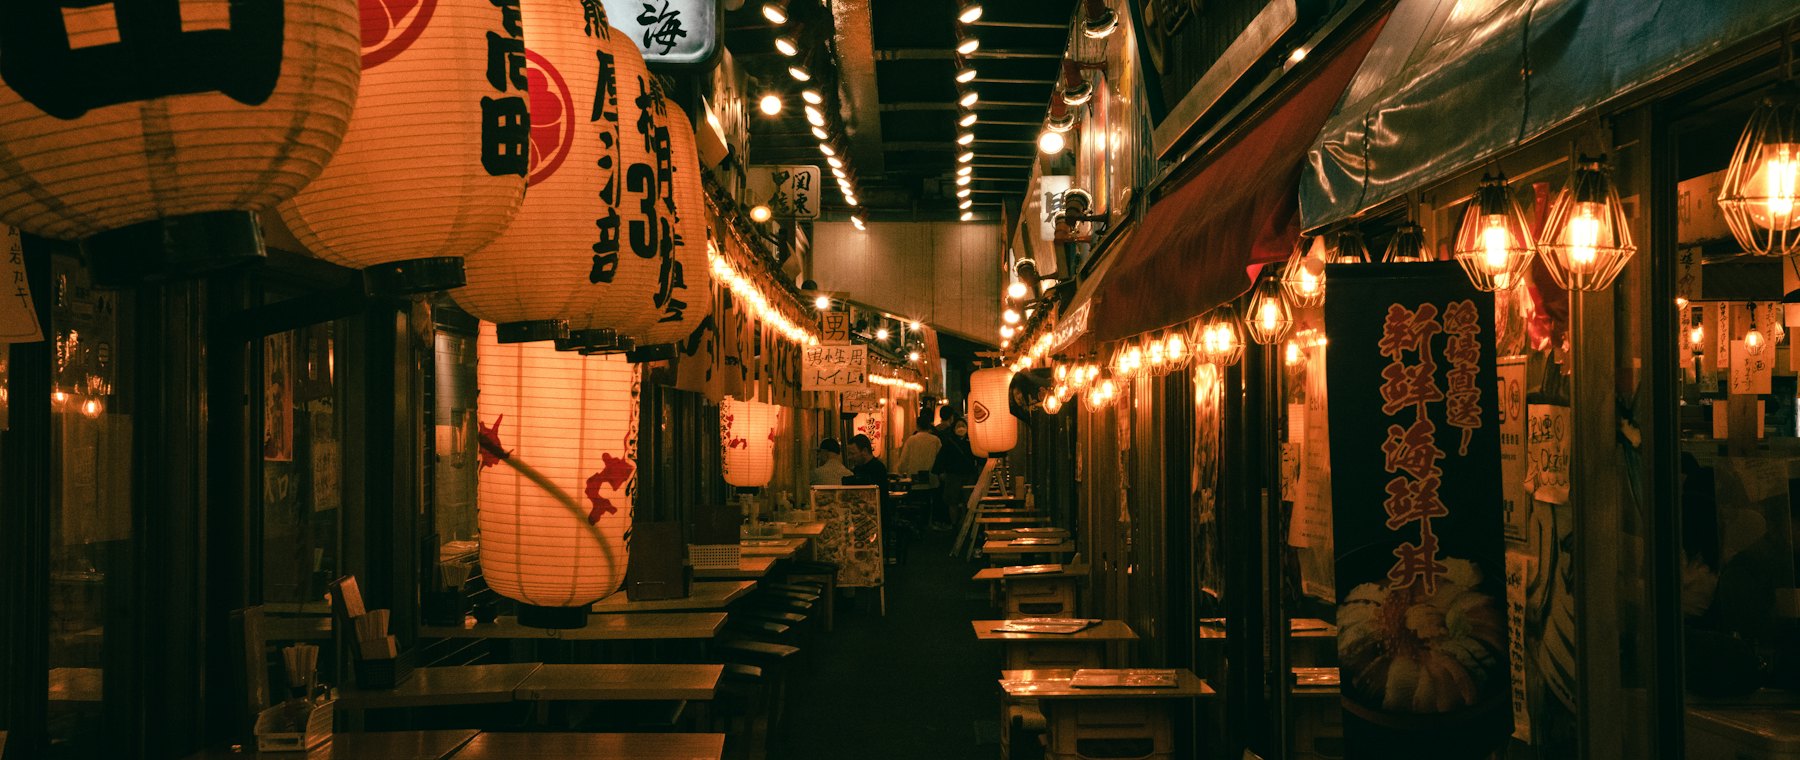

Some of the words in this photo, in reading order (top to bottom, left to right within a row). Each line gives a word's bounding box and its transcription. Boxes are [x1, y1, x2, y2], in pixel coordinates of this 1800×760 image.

[792, 171, 811, 214] 関東
[826, 315, 846, 341] 男
[807, 348, 863, 367] 男性用
[1379, 302, 1449, 597] 新鮮海鮮丼
